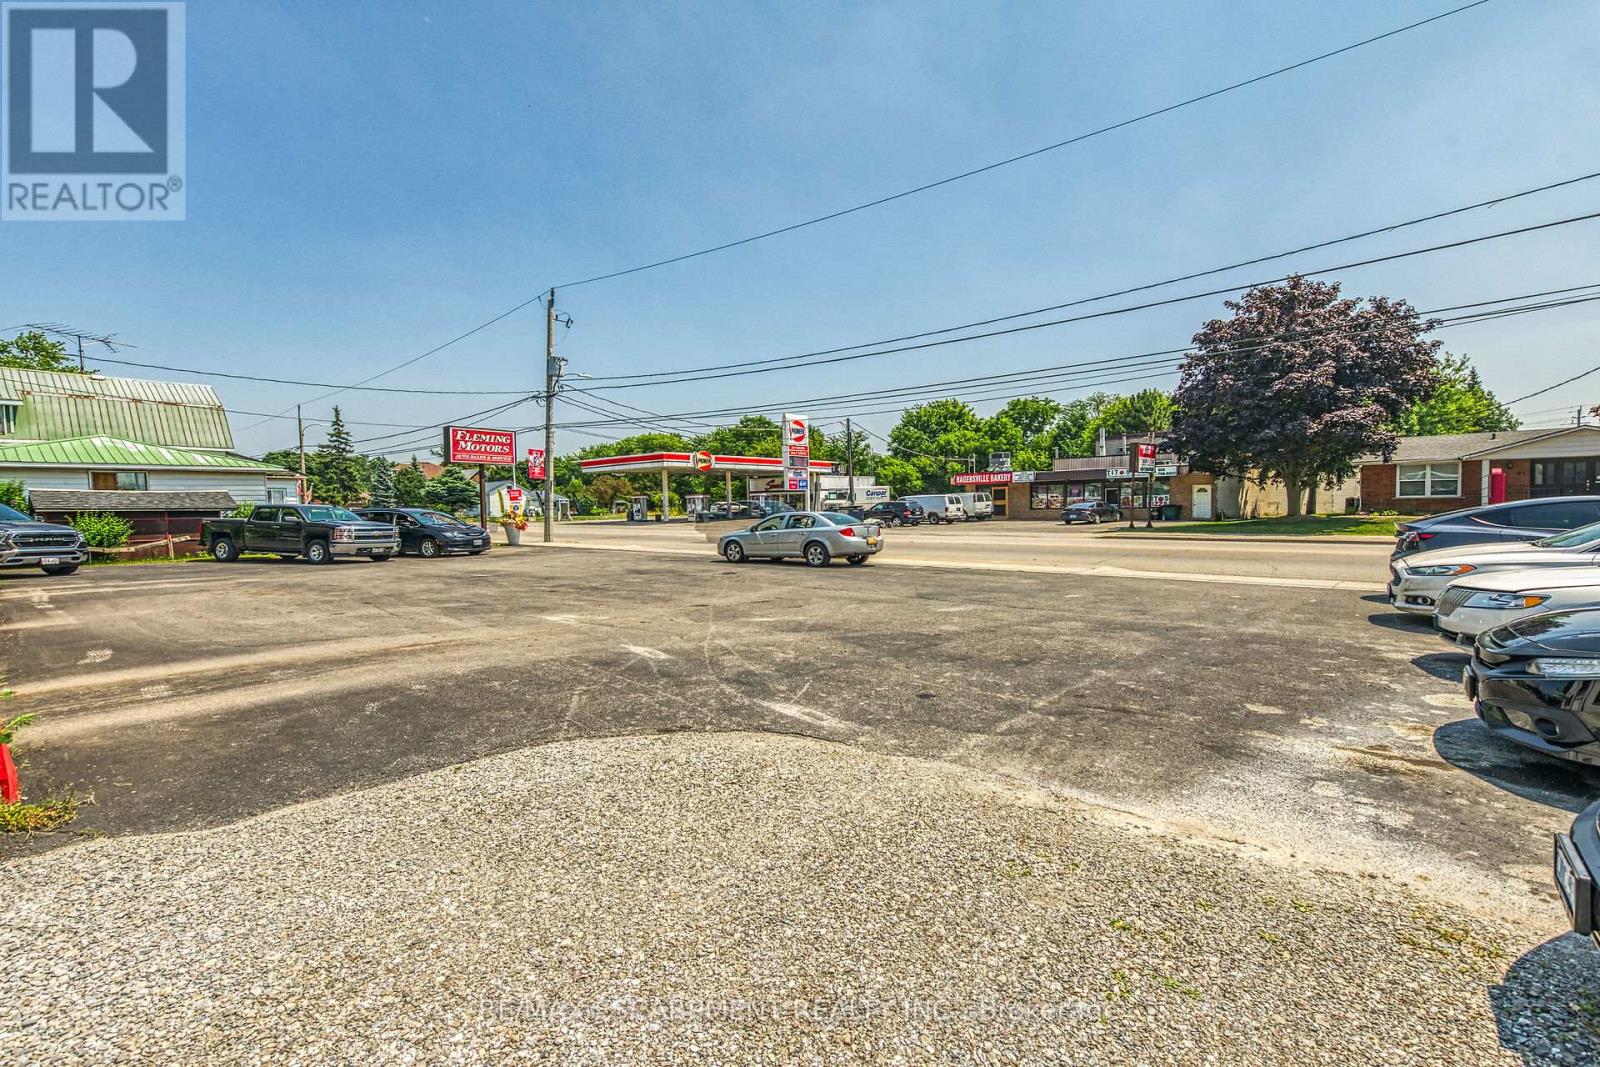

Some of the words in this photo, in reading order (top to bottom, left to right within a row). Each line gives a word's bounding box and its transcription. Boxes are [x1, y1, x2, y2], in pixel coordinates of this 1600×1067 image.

[456, 430, 510, 444] FLEMING
[458, 441, 510, 453] MOTORS
[990, 473, 1011, 482] BAKERY
